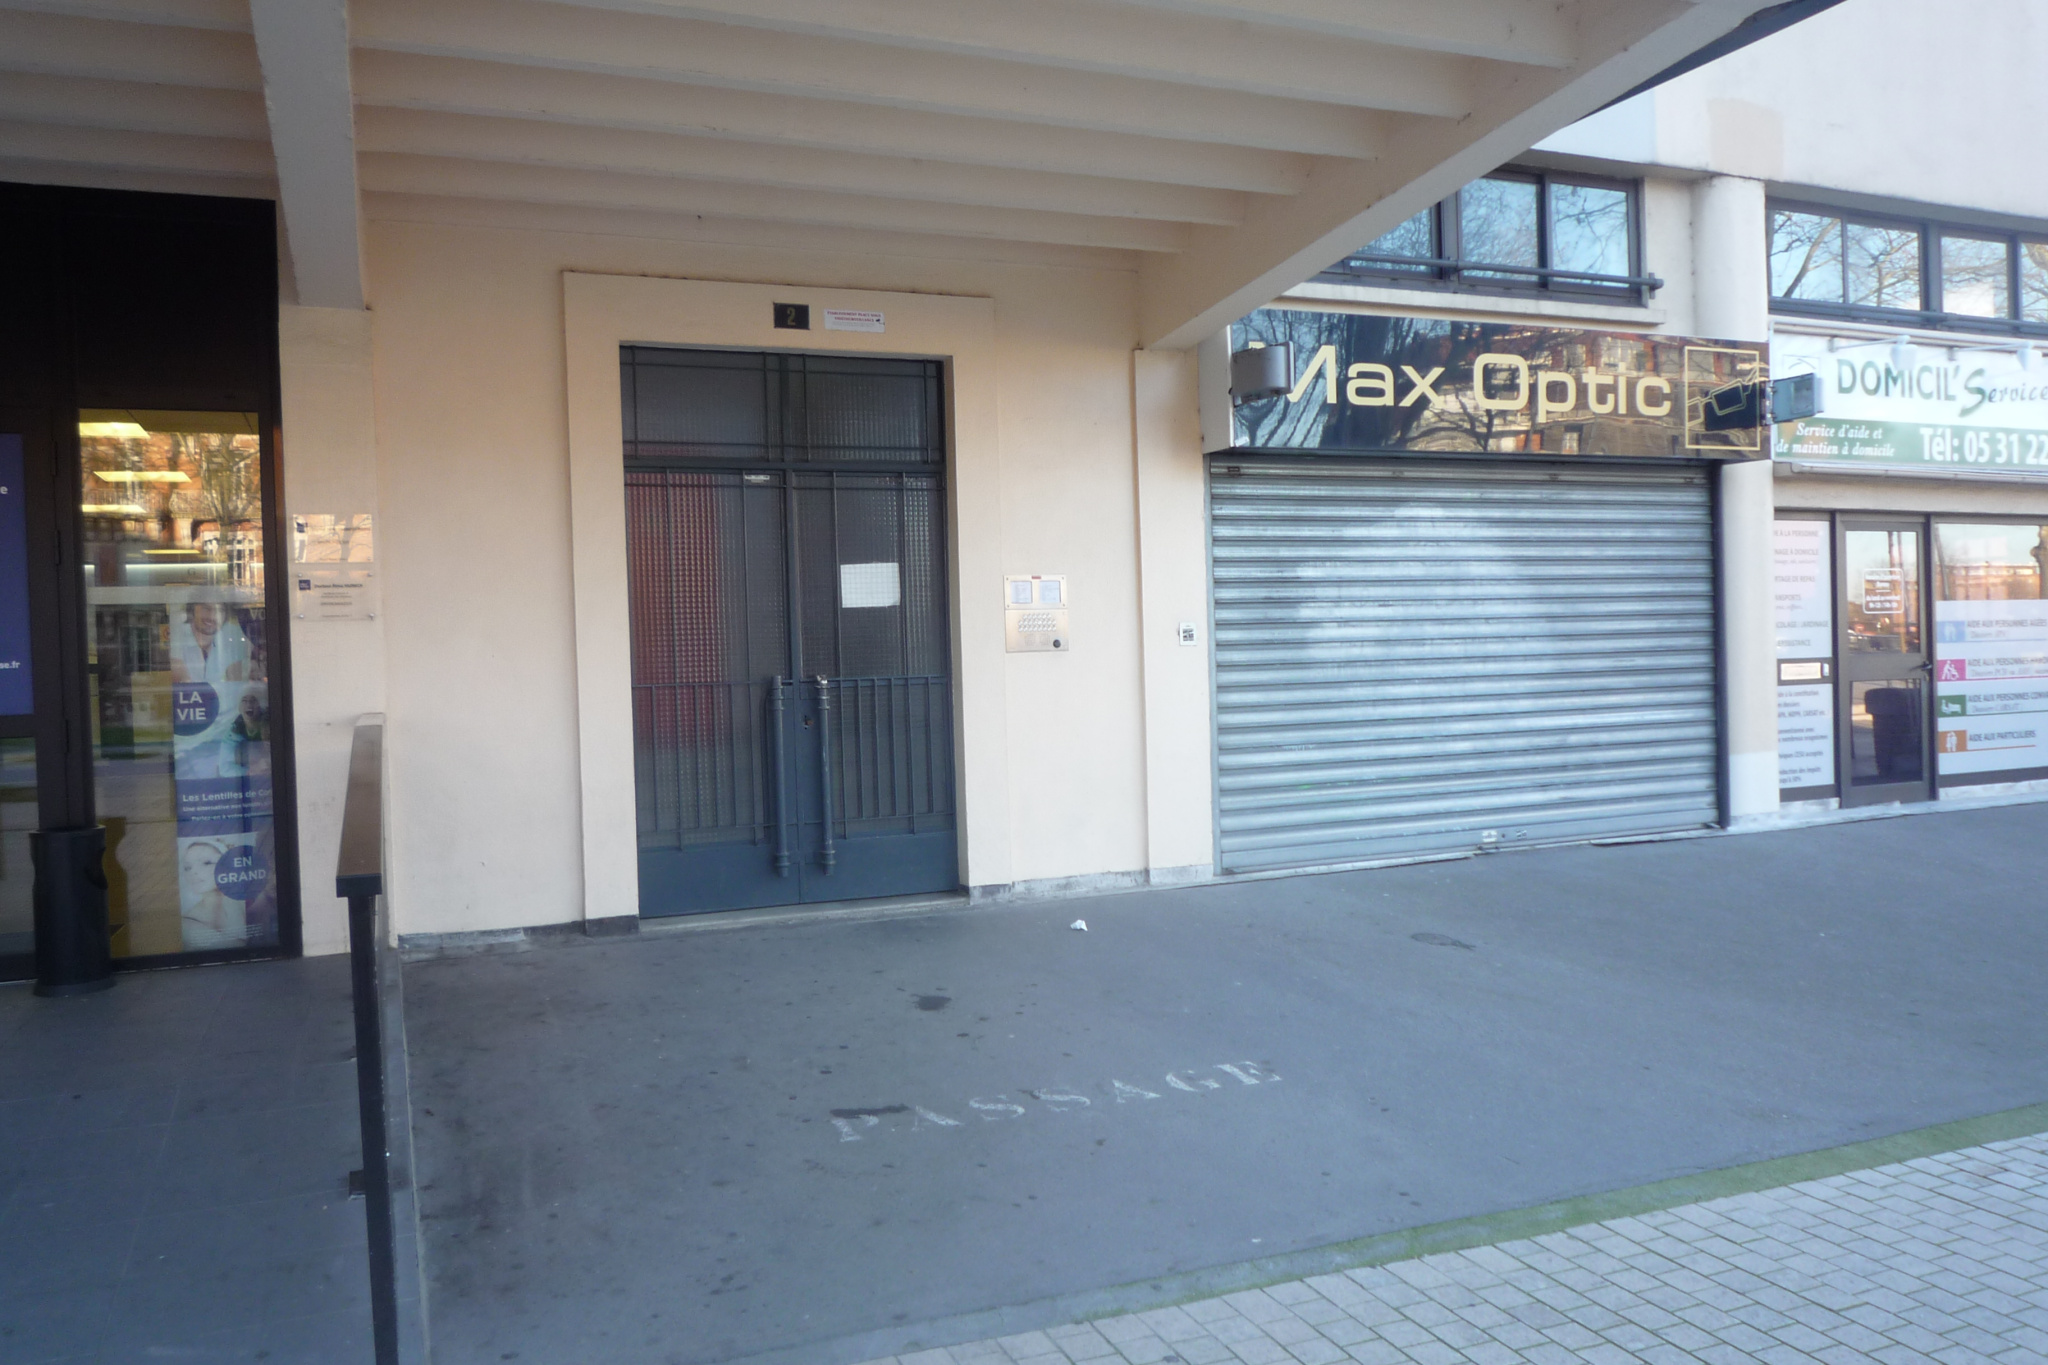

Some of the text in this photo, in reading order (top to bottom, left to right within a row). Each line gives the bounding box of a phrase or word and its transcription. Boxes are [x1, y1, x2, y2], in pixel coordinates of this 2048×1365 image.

[787, 307, 796, 326] 2
[1473, 353, 1672, 423] Optic
[1796, 422, 1883, 439] Service d'aide et
[1776, 439, 1895, 457] de maintien à domicile
[1920, 427, 1960, 462] Tél:
[1963, 430, 1990, 463] 05
[1995, 432, 2019, 464] 31
[179, 691, 203, 704] LA
[177, 708, 207, 721] VIE
[182, 794, 199, 802] Les
[202, 792, 243, 801] Lentilles
[245, 790, 257, 798] de
[233, 855, 252, 868] EN
[218, 869, 267, 884] GRAND
